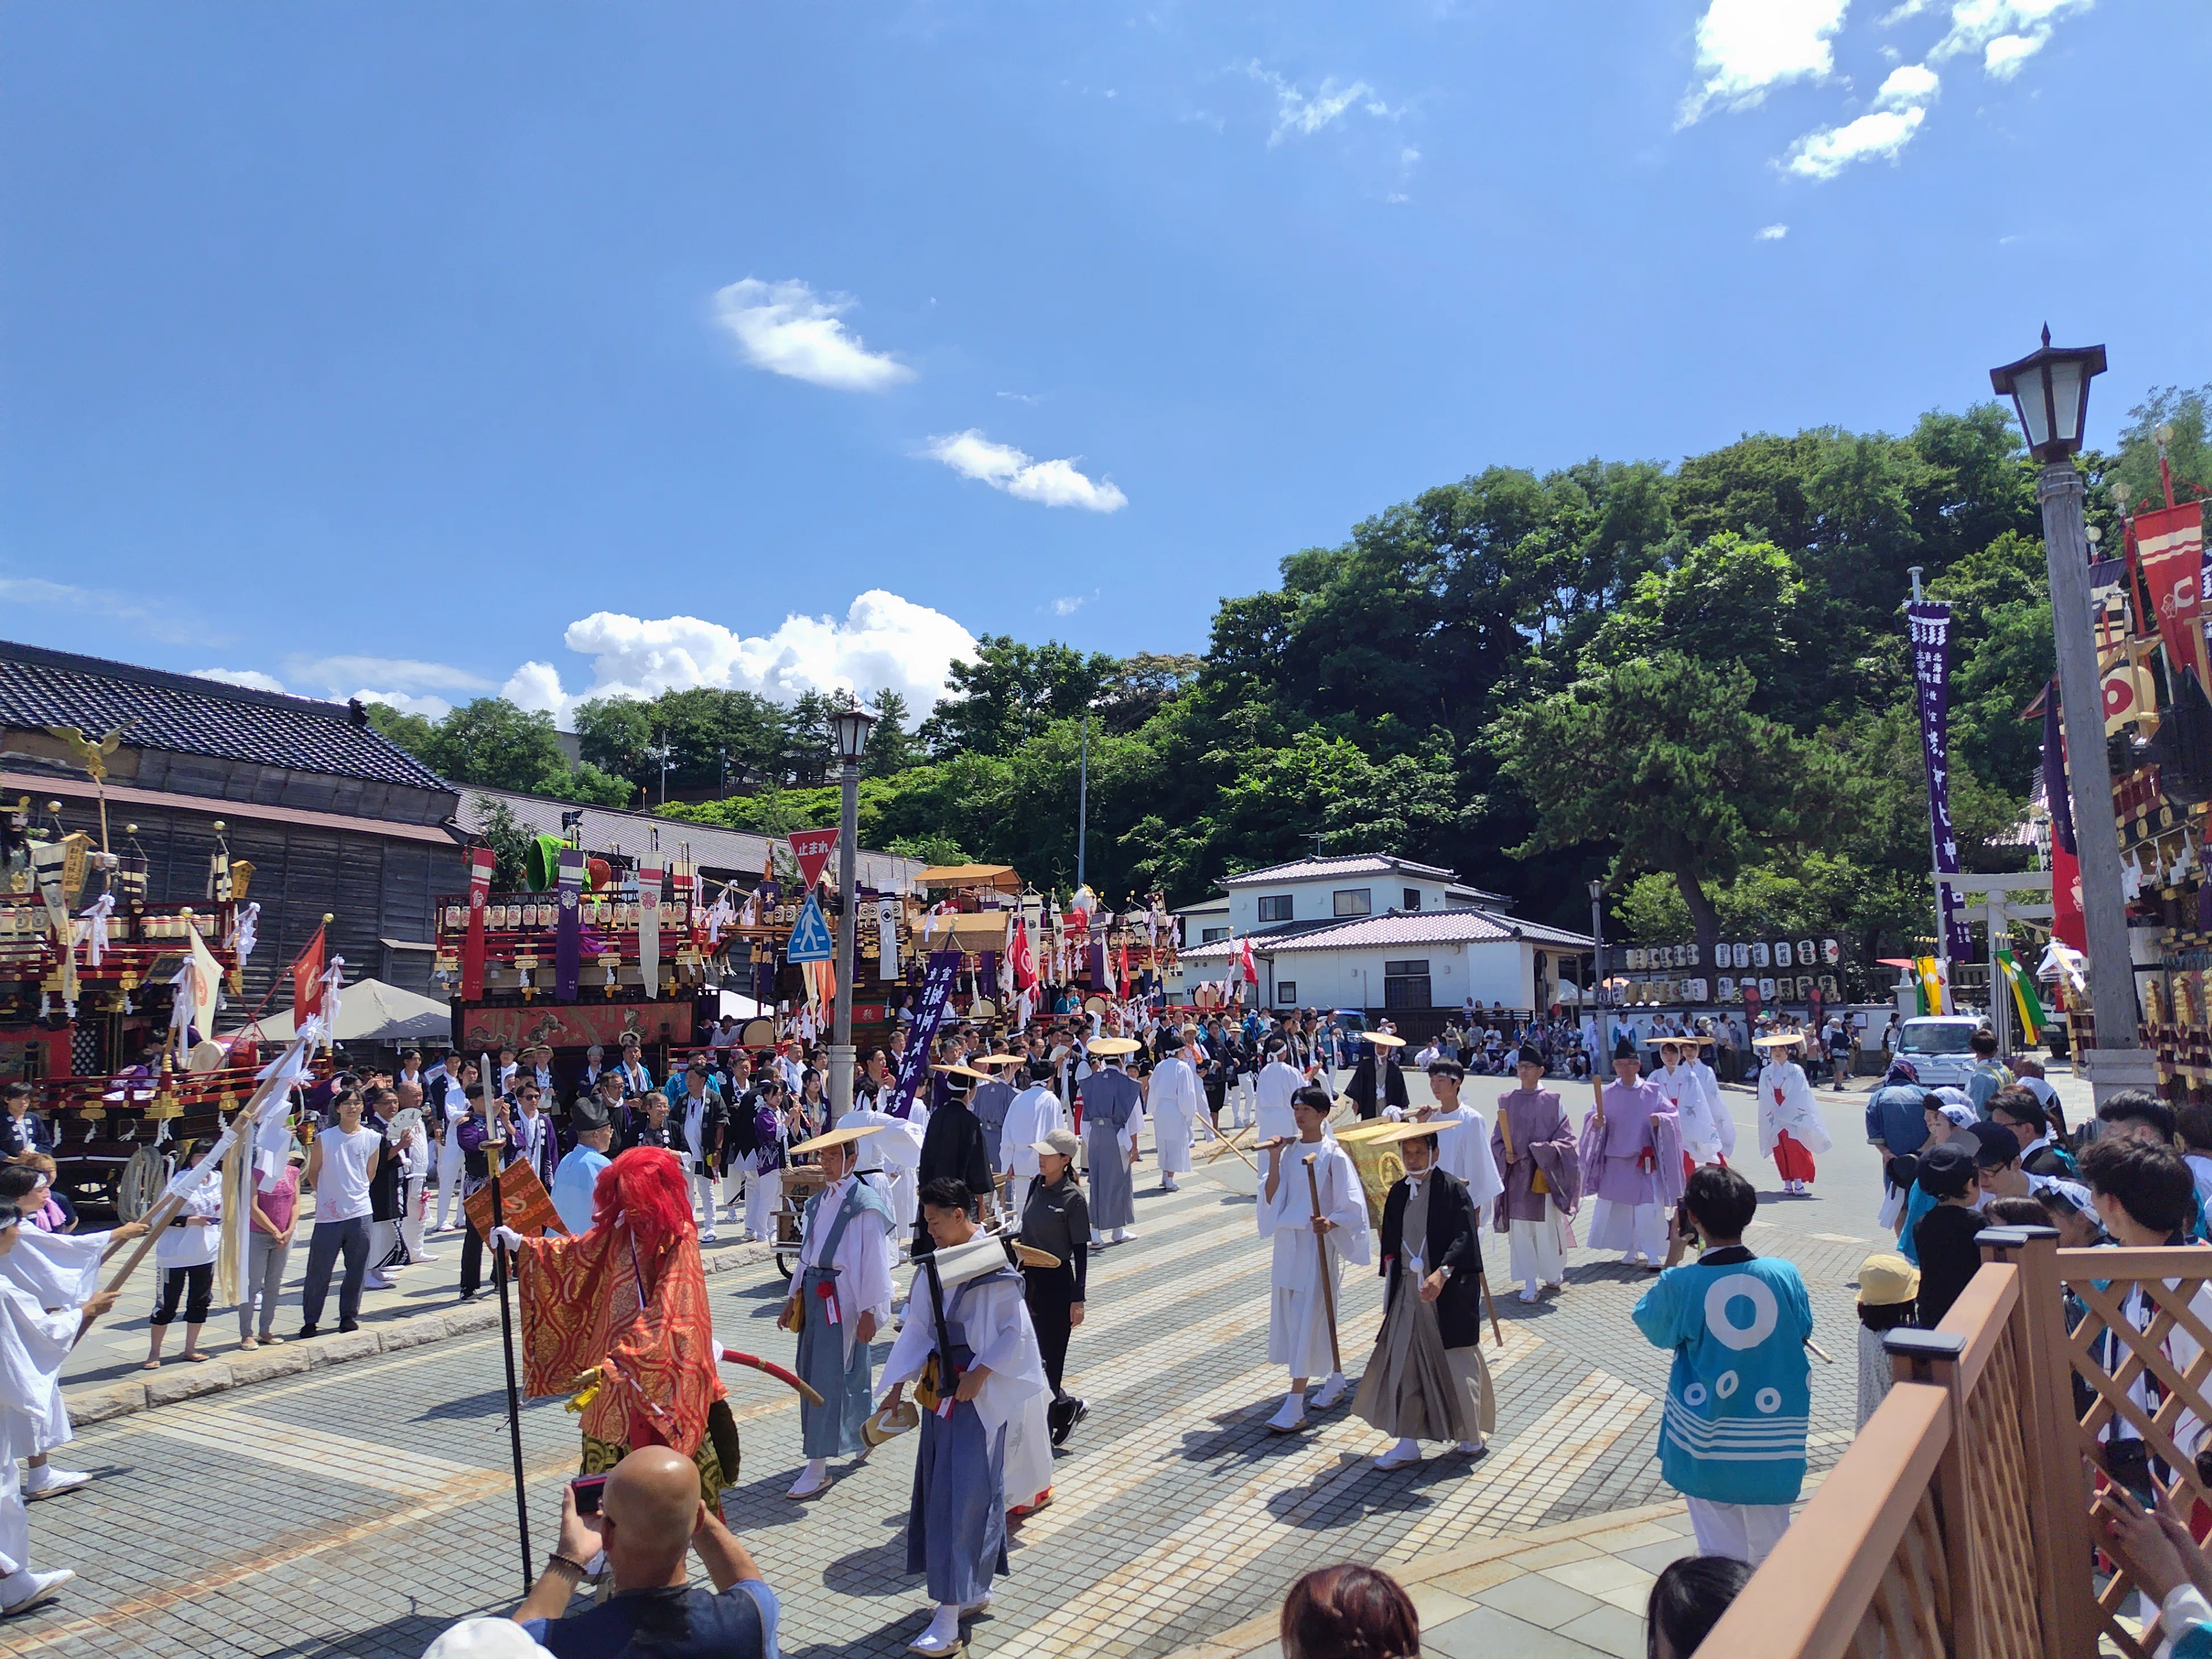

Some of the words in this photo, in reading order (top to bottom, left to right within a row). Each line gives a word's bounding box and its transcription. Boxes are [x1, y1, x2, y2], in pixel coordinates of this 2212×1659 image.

[1932, 652, 1943, 684] 北海道
[797, 840, 829, 857] 止まれ
